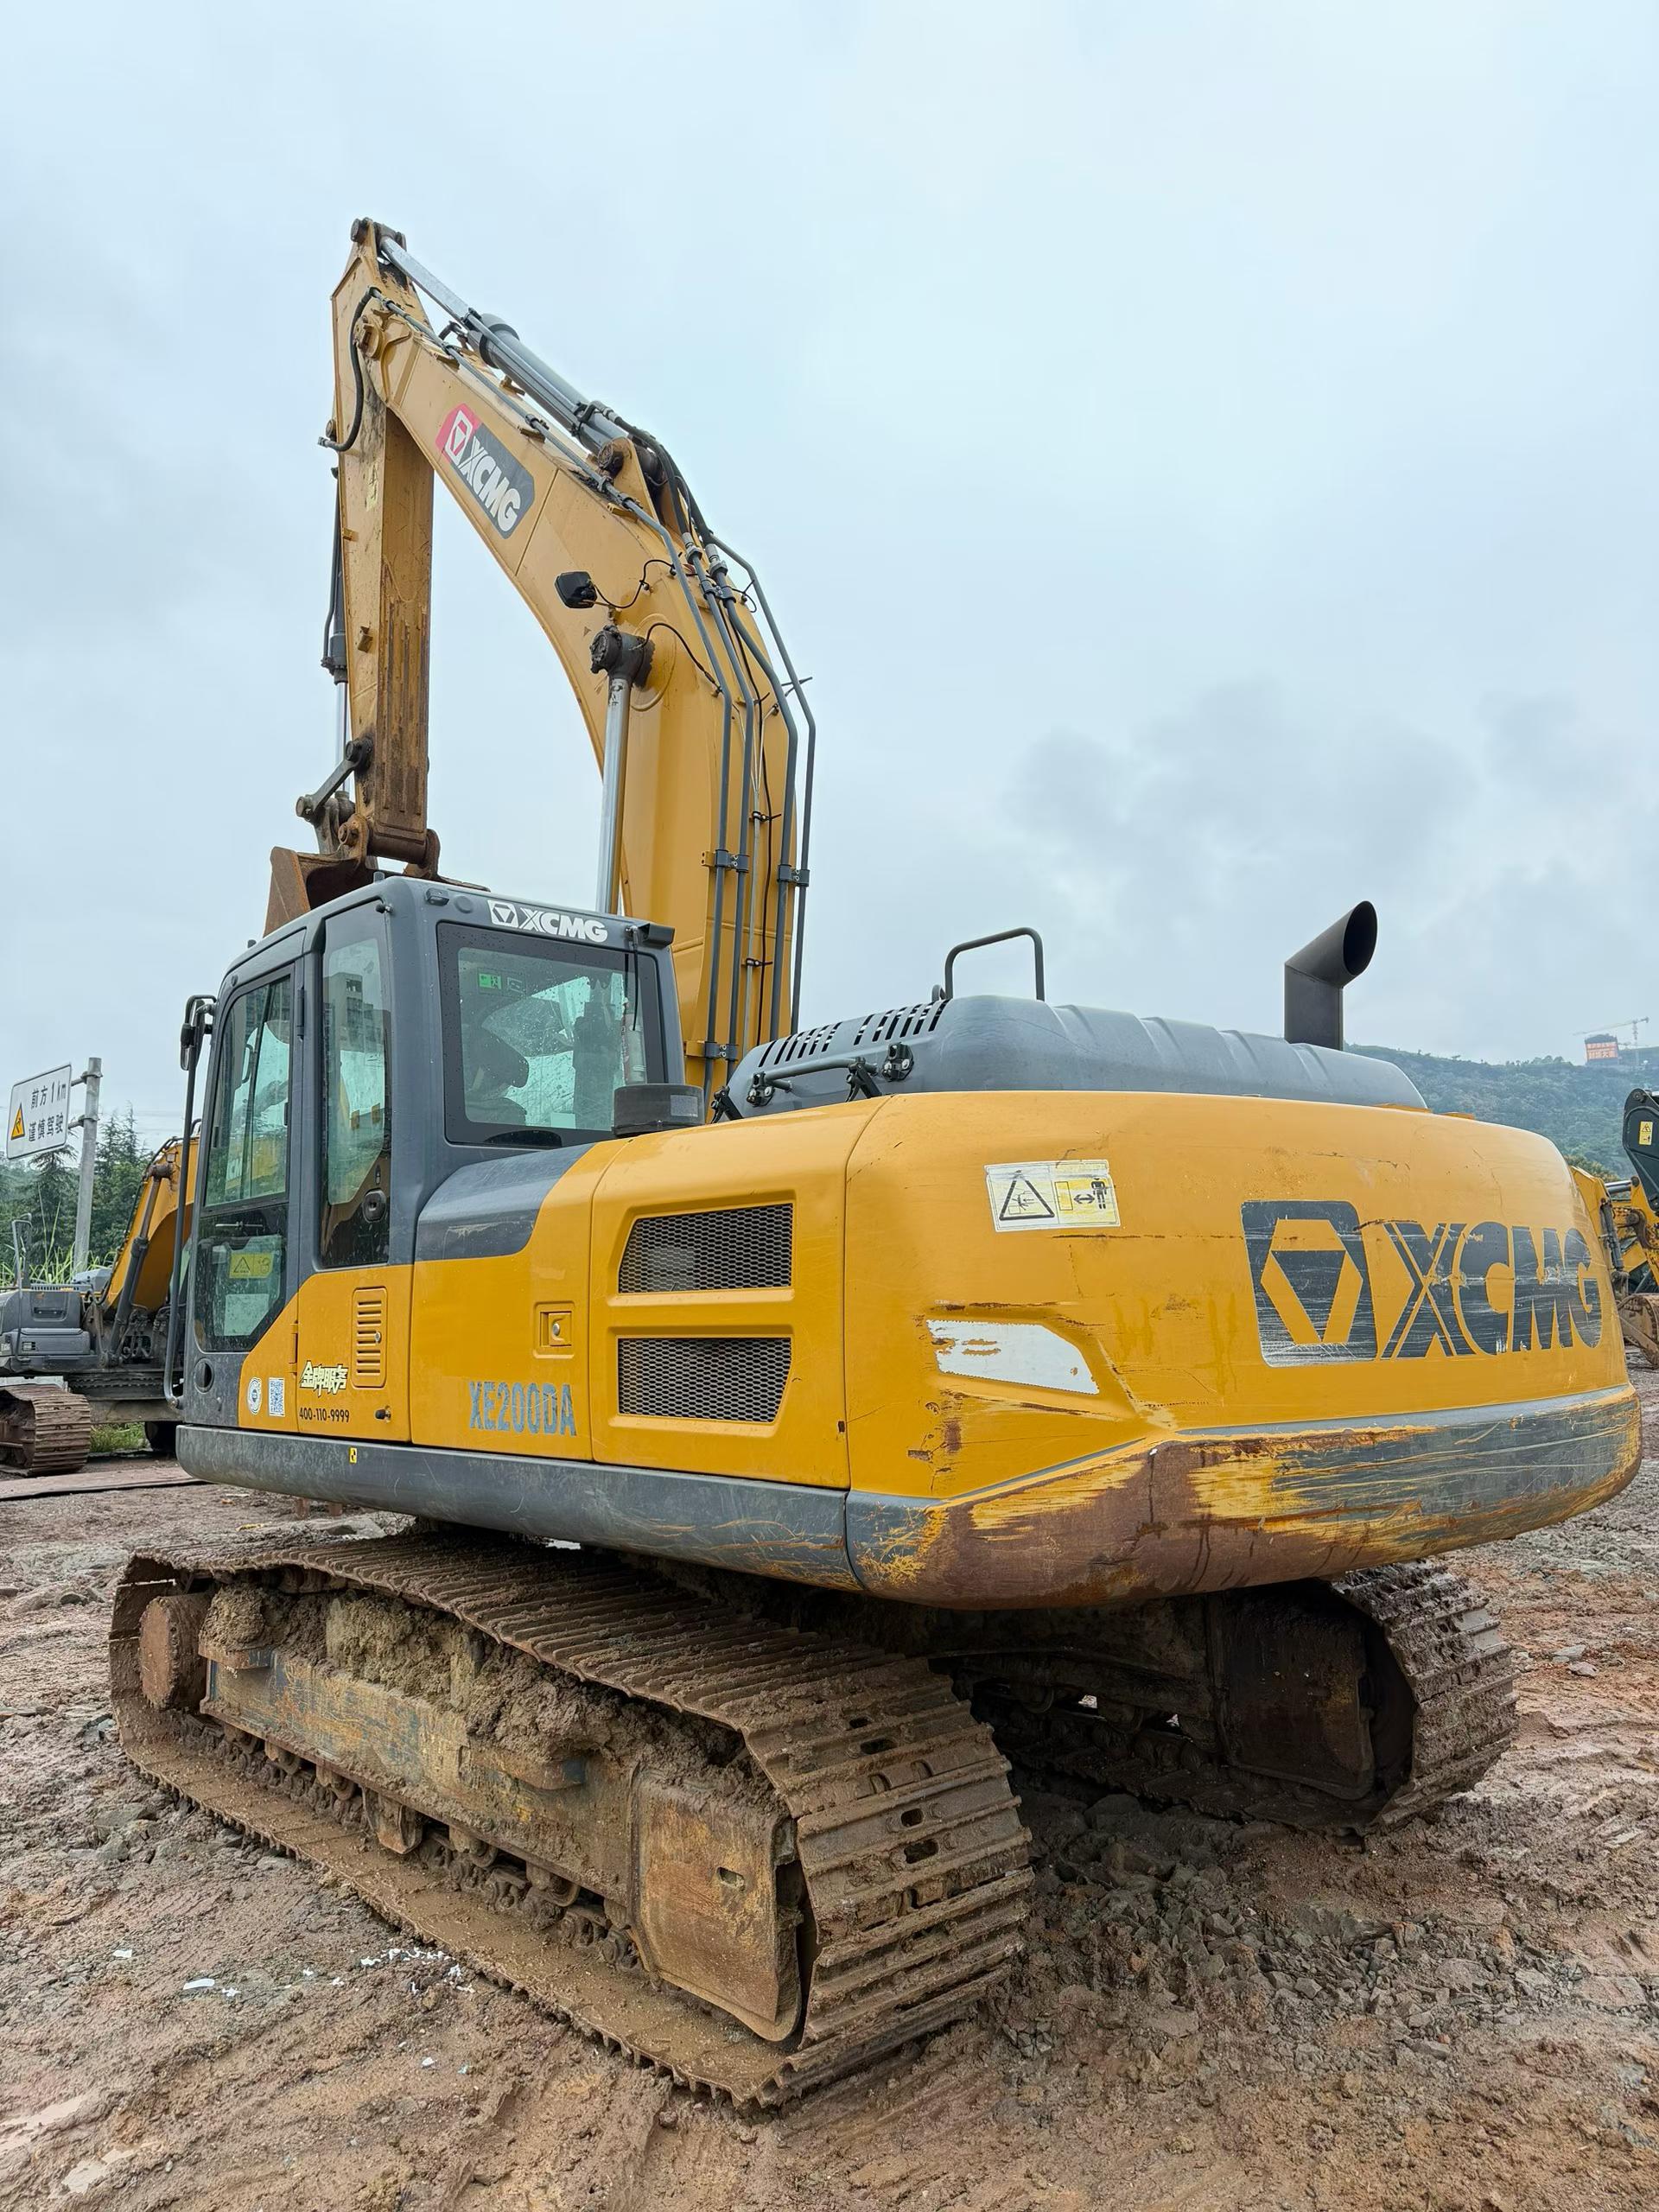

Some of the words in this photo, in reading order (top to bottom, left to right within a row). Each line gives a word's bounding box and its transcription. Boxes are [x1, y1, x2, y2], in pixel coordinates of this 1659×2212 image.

[457, 435, 521, 532] XCMG
[518, 907, 608, 943] XCMG
[1381, 1221, 1603, 1359] XCMG
[299, 1408, 350, 1423] 400-110-9999
[468, 1381, 577, 1436] XE200DA
